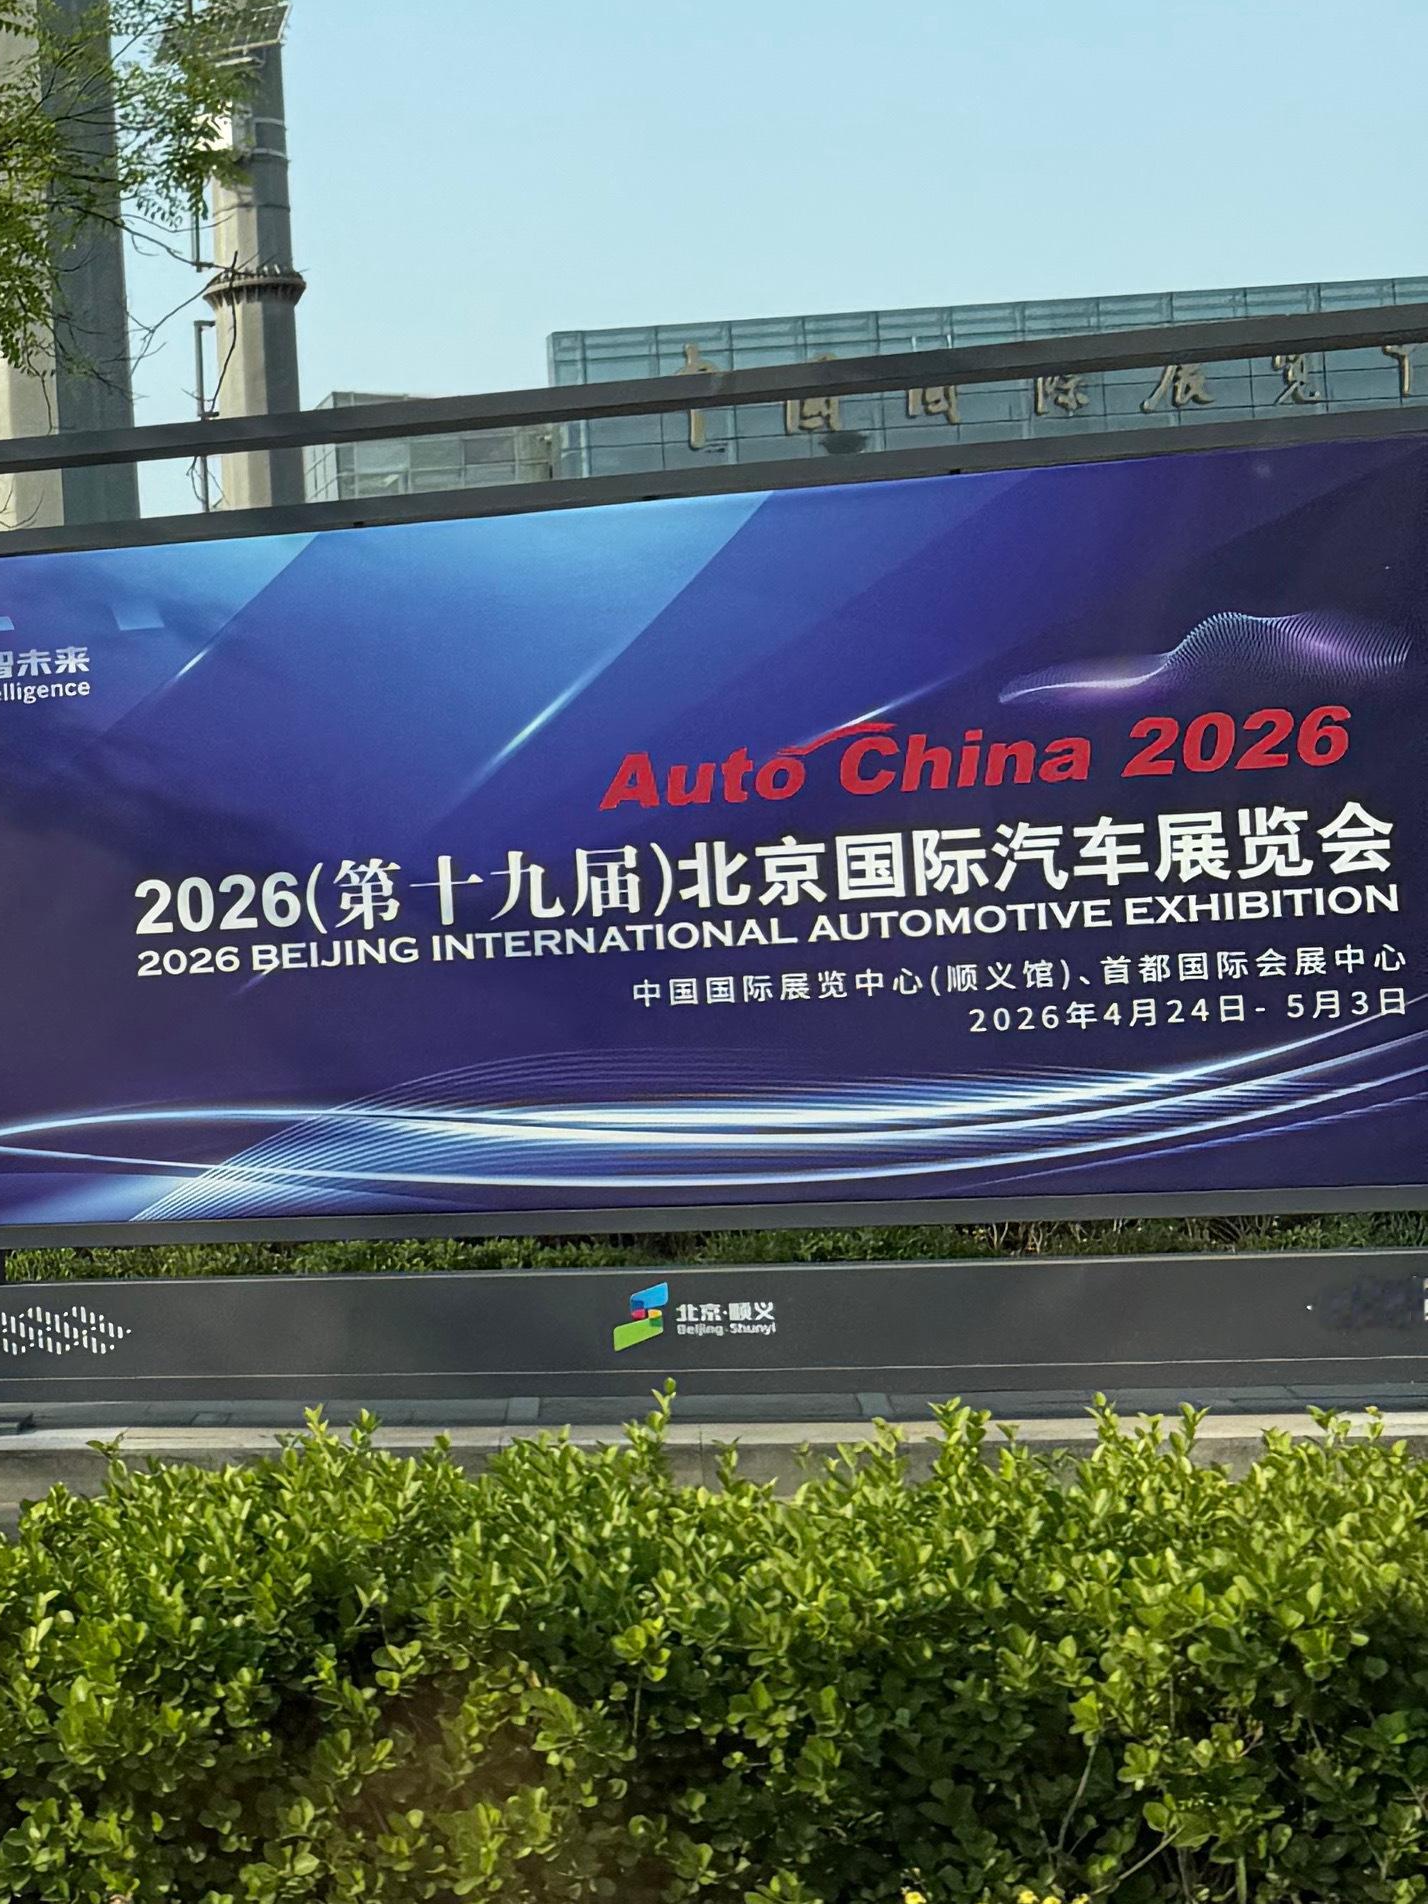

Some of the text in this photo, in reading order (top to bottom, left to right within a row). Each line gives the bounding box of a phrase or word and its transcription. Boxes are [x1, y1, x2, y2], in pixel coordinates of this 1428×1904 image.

[599, 706, 1351, 811] Auto China 2026
[134, 801, 1394, 935] 2026(第十九届)北京国际汽车展览会
[137, 883, 1400, 977] 2026 BEIJING INTERNATIONAL AUTOMOTIVE EXHIBITION
[633, 943, 1407, 1008] 中国国际展览中心(顺义馆)、首都国际会展中心
